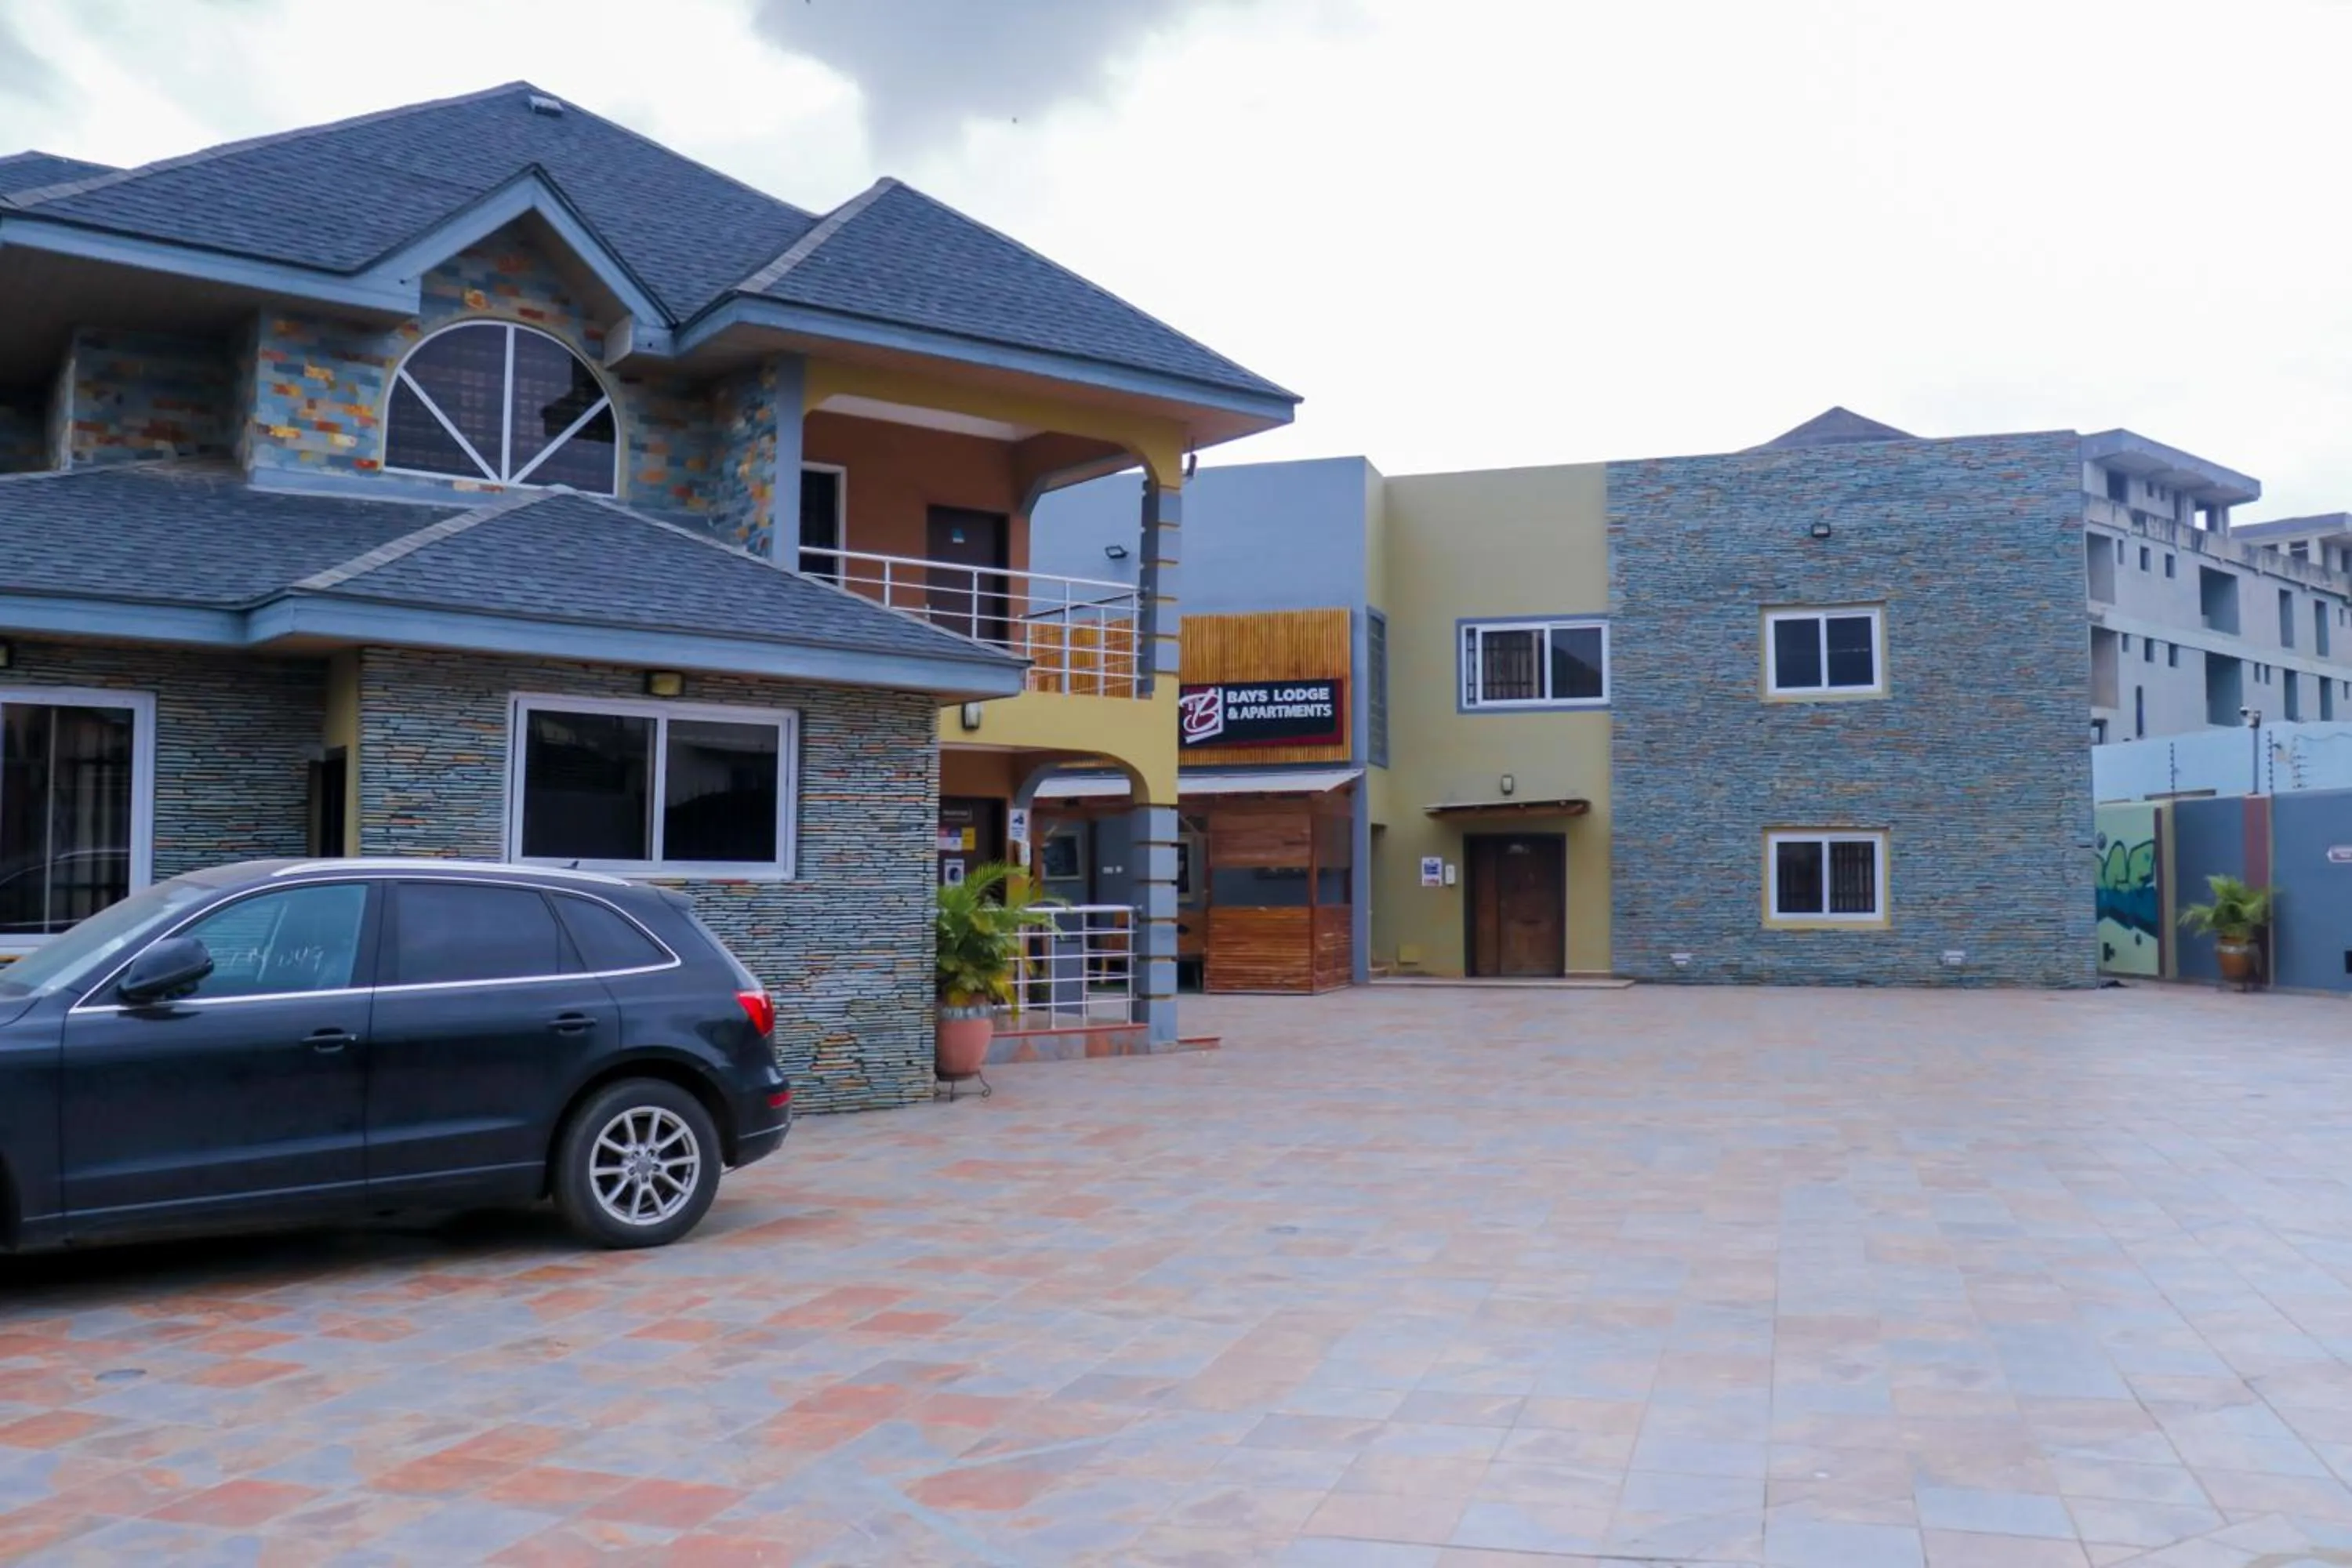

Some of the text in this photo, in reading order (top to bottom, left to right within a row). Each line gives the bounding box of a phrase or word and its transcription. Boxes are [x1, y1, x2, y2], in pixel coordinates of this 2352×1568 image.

[1227, 688, 1330, 704] BAYS LODGE
[1228, 704, 1332, 720] & APARTMENTS
